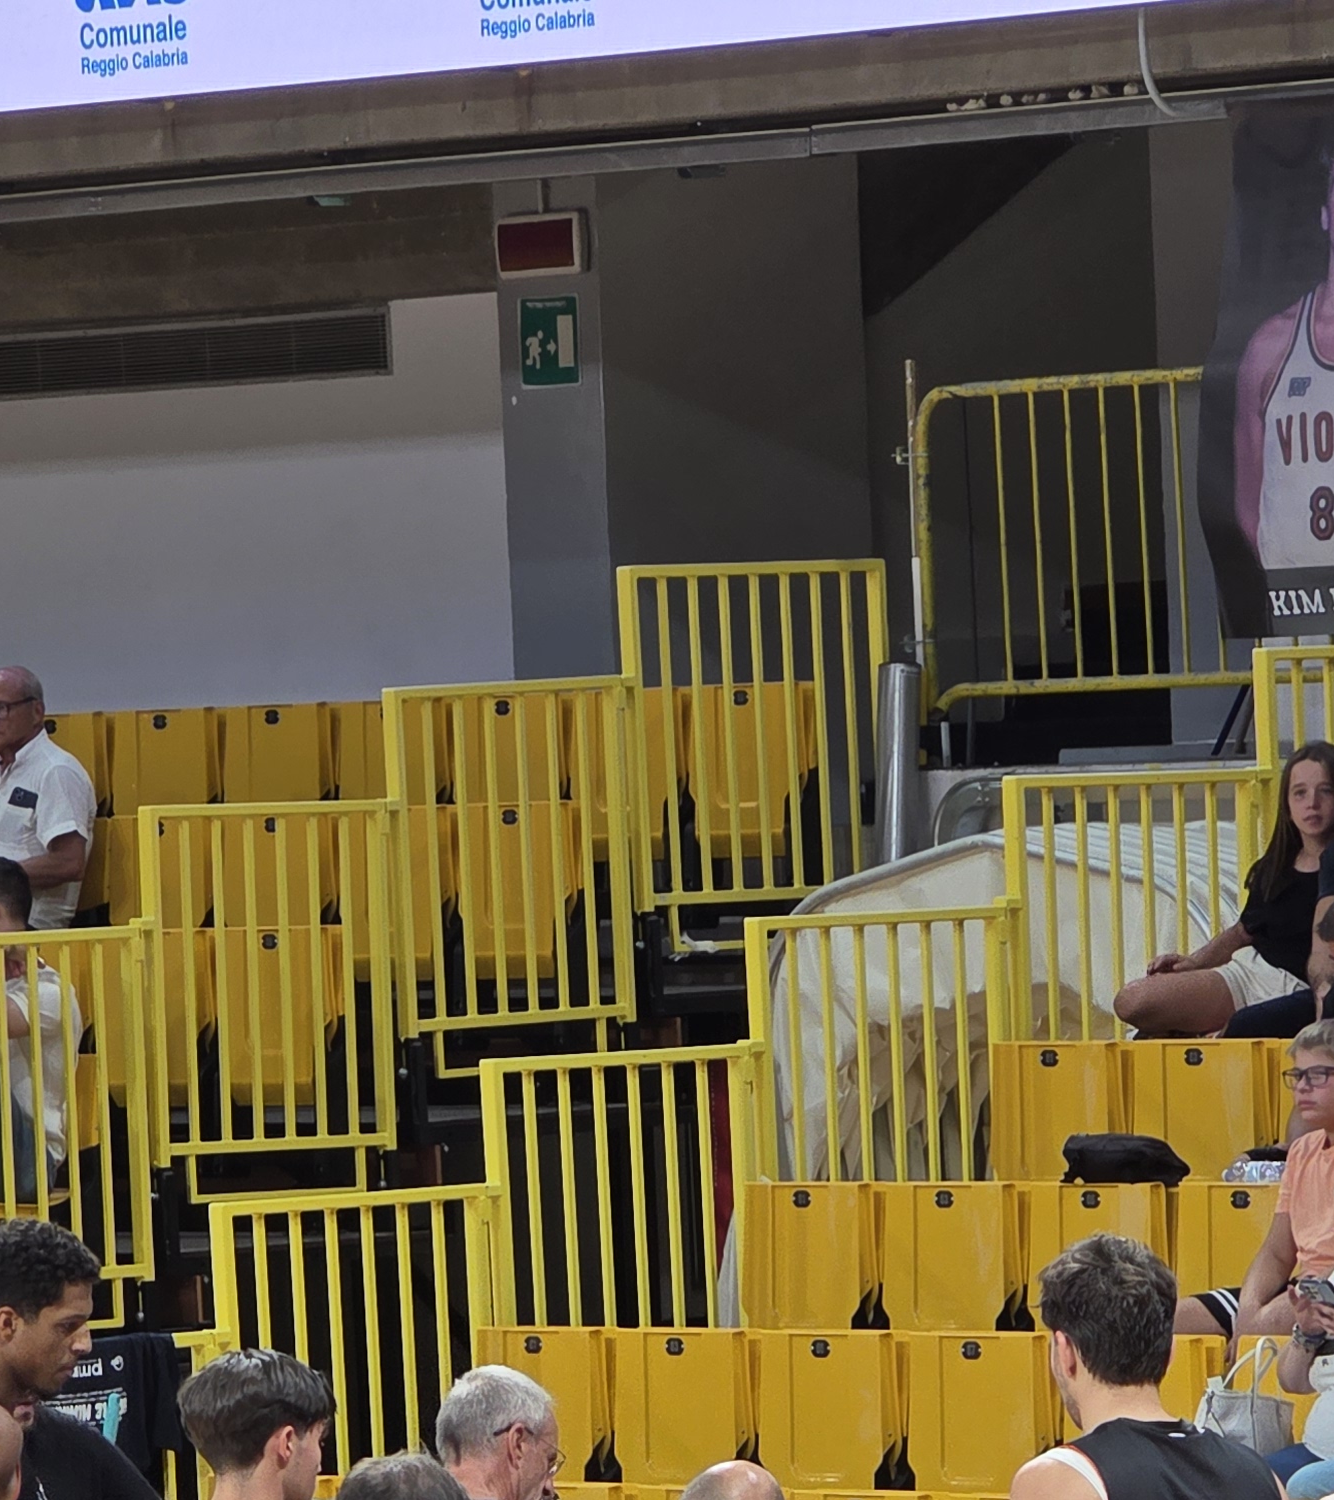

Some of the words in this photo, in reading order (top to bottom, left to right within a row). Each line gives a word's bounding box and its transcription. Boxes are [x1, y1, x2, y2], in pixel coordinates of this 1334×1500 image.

[80, 14, 187, 49] Comunale
[480, 14, 531, 38] Reggio
[535, 8, 595, 32] Calabria
[81, 53, 129, 78] Reggio
[132, 46, 188, 71] Calabria
[1269, 587, 1326, 617] KIM
